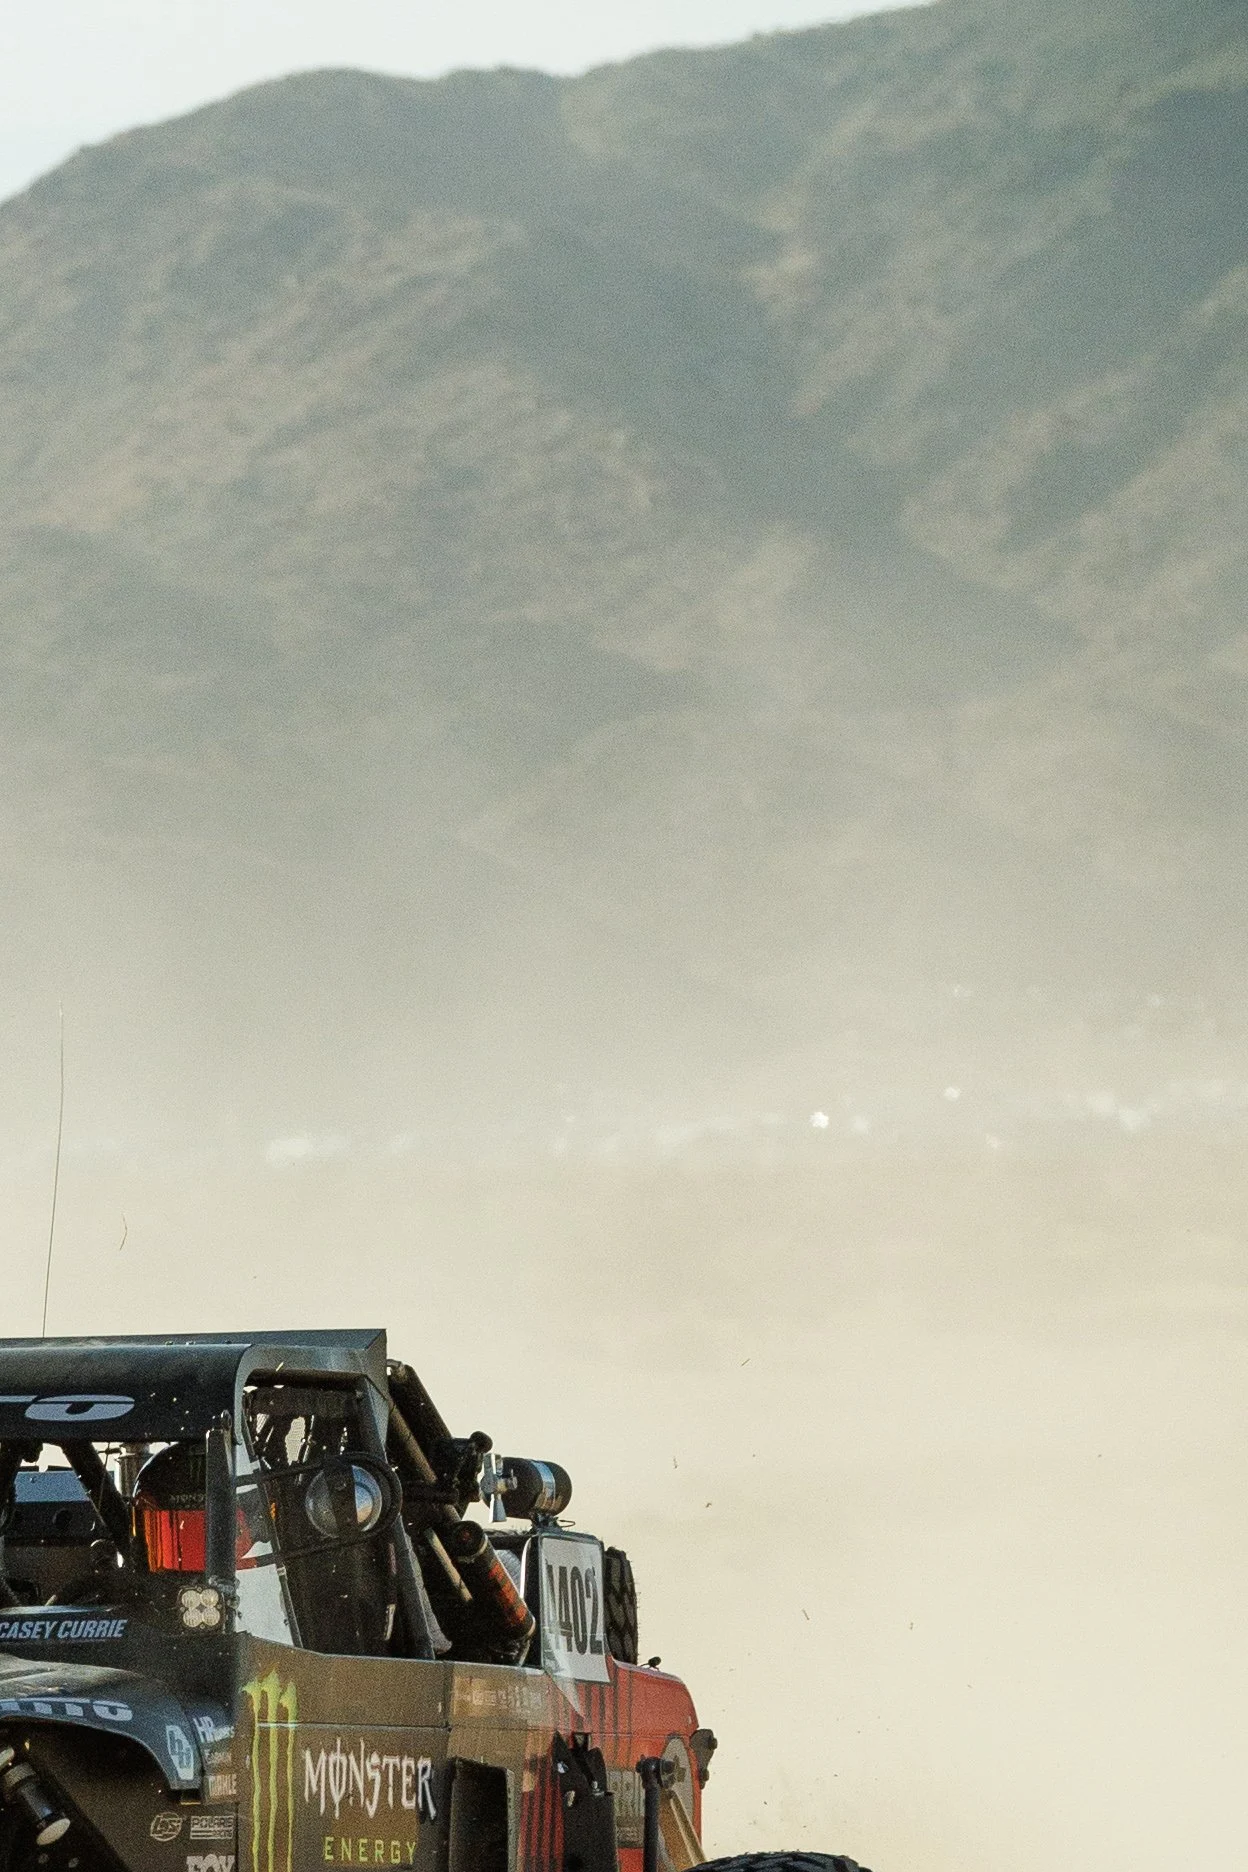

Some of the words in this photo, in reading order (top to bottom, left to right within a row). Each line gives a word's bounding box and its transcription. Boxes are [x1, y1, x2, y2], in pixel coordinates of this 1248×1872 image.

[57, 1619, 128, 1639] CURRIE
[303, 1737, 438, 1820] MONSTER
[323, 1836, 416, 1865] ENERGY
